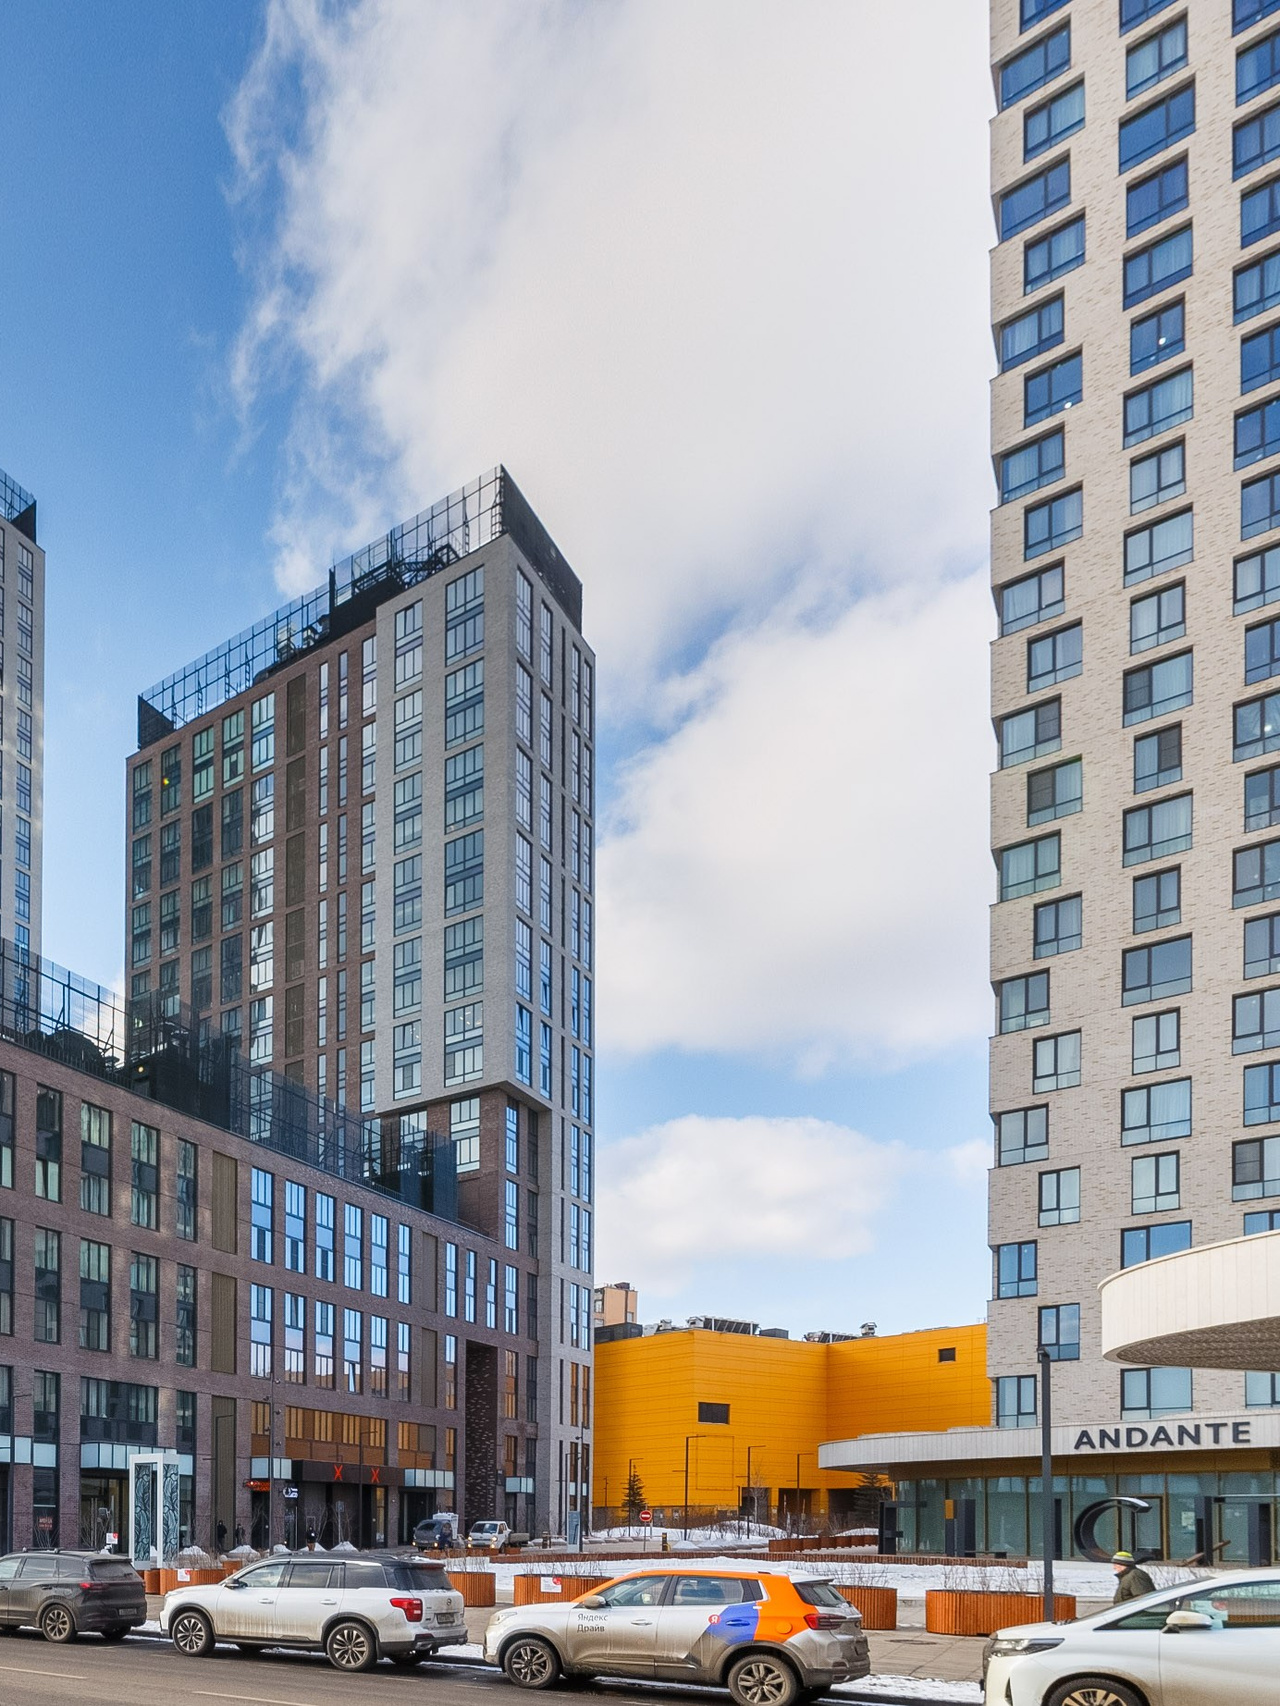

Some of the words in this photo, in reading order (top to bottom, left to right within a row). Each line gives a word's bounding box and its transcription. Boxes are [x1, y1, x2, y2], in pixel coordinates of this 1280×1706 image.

[1074, 1421, 1251, 1450] ANDANTE
[577, 1613, 608, 1622] Яндекс
[577, 1624, 605, 1633] Драйв
